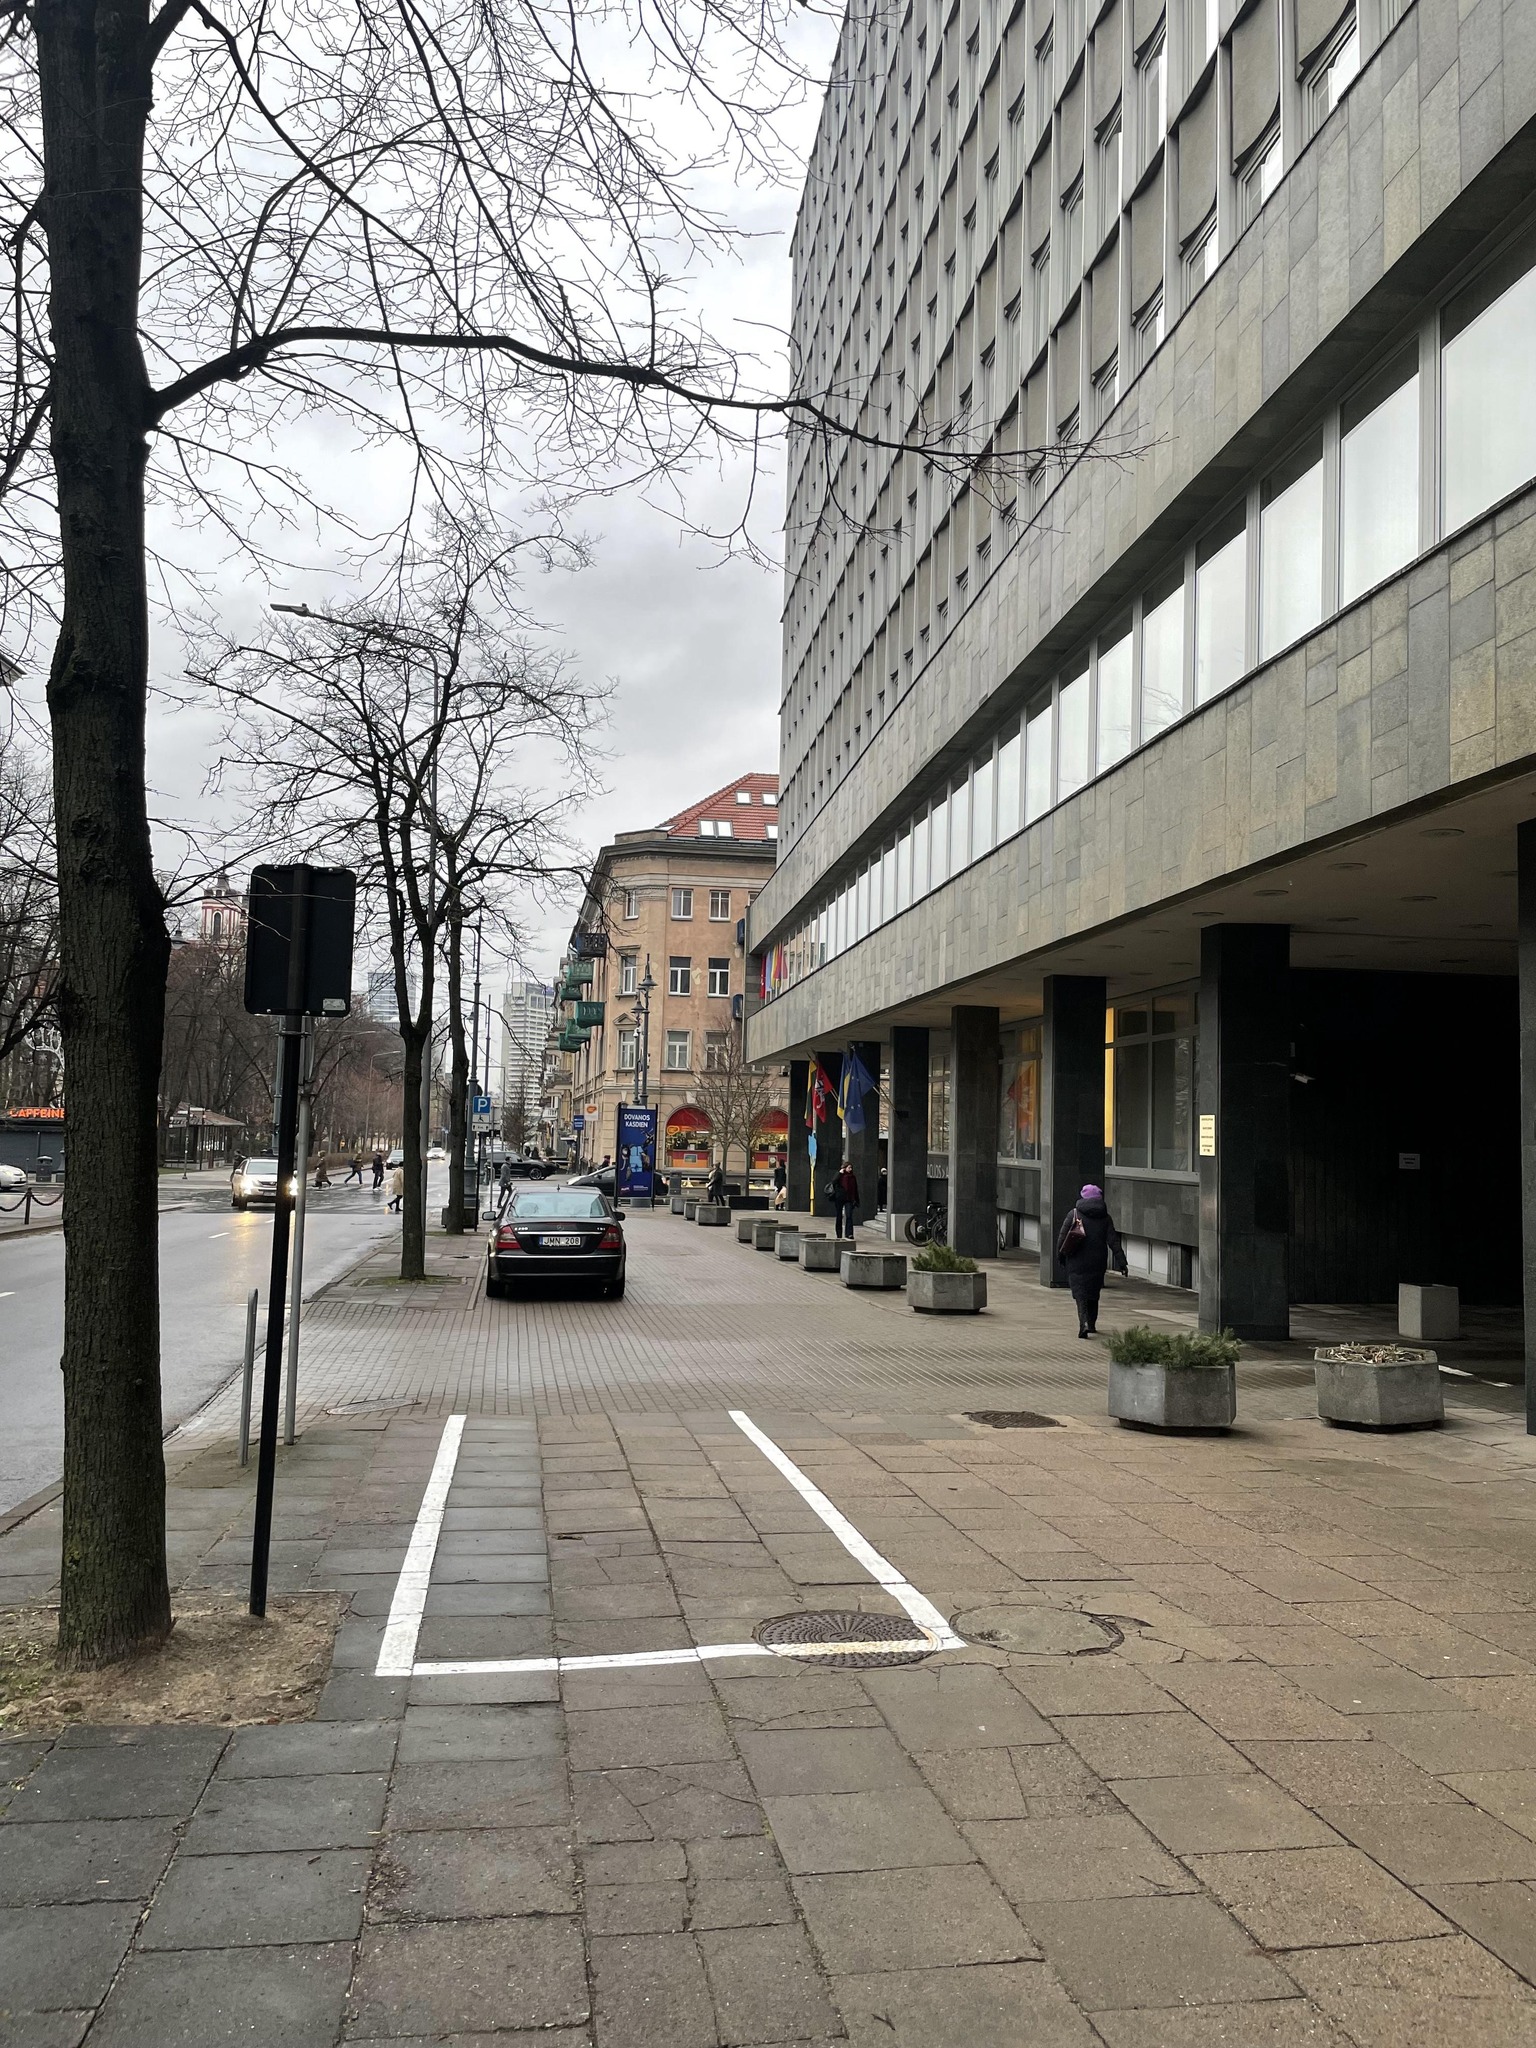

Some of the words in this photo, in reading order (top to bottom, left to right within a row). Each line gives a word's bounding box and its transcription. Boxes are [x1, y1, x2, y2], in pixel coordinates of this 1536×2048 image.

[477, 1098, 488, 1112] P
[623, 1113, 651, 1121] DOVANOS
[543, 1237, 561, 1245] JMN
[565, 1237, 580, 1245] 208
